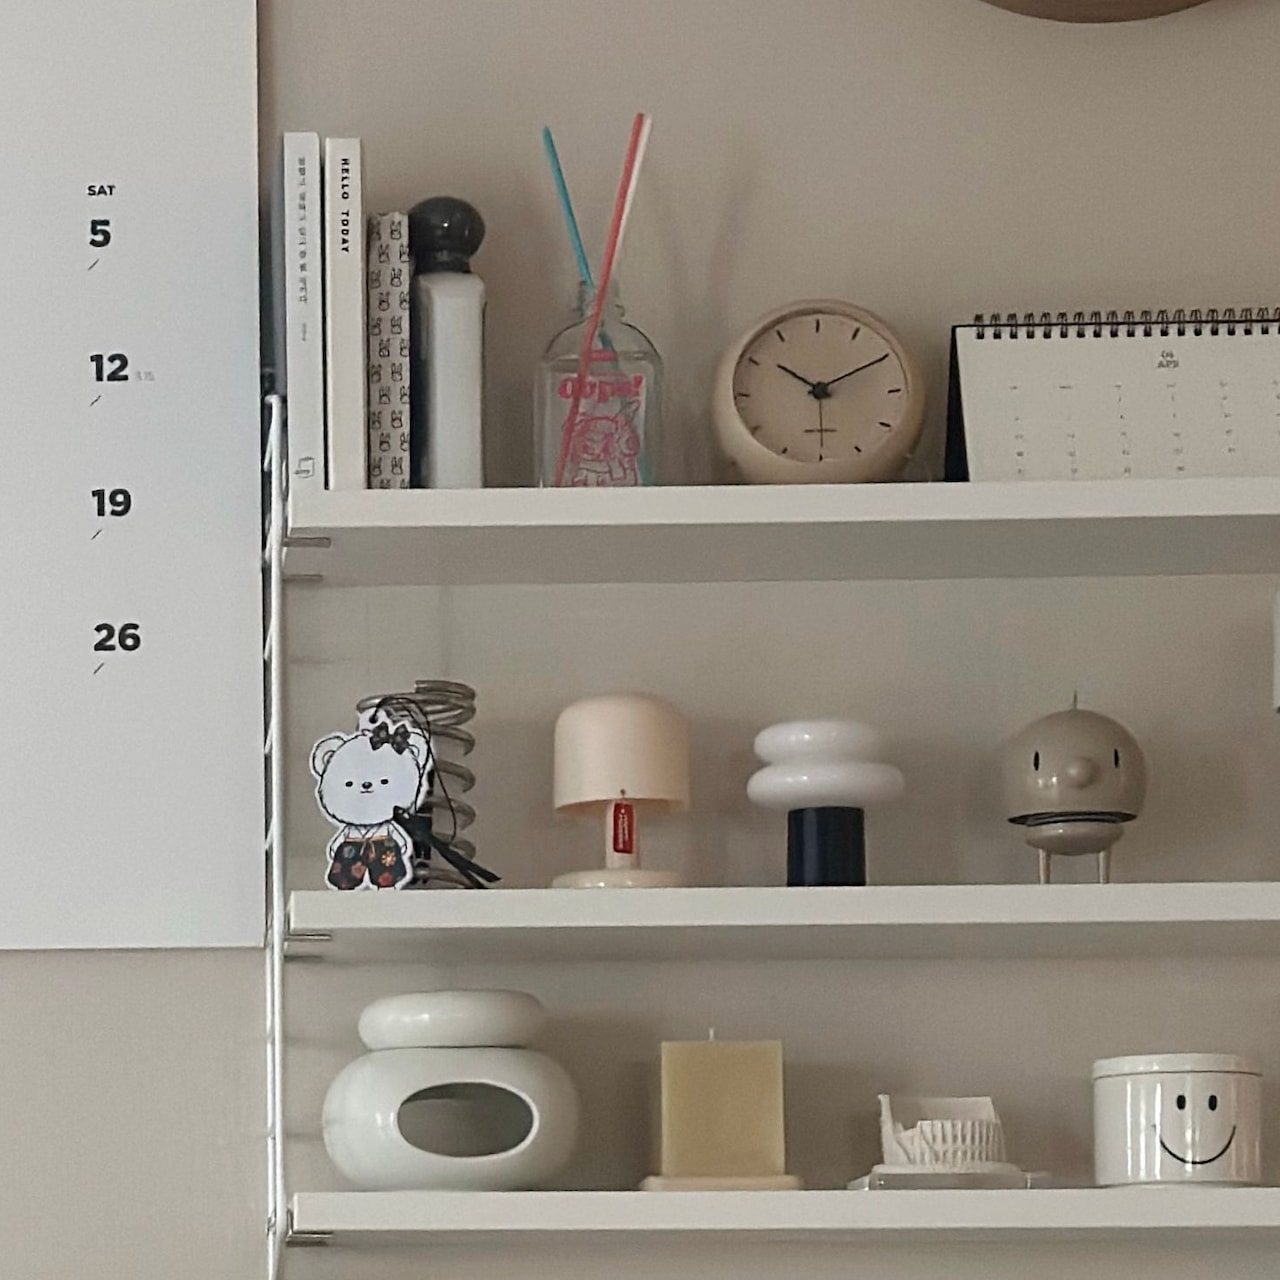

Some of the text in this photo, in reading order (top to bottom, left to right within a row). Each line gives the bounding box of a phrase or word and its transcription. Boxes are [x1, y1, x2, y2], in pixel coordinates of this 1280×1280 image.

[87, 185, 116, 196] SAT
[340, 158, 350, 253] HELLO TODAY
[89, 219, 111, 248] 5
[89, 353, 129, 382] 12
[91, 488, 132, 517] 19
[93, 622, 141, 652] 26
